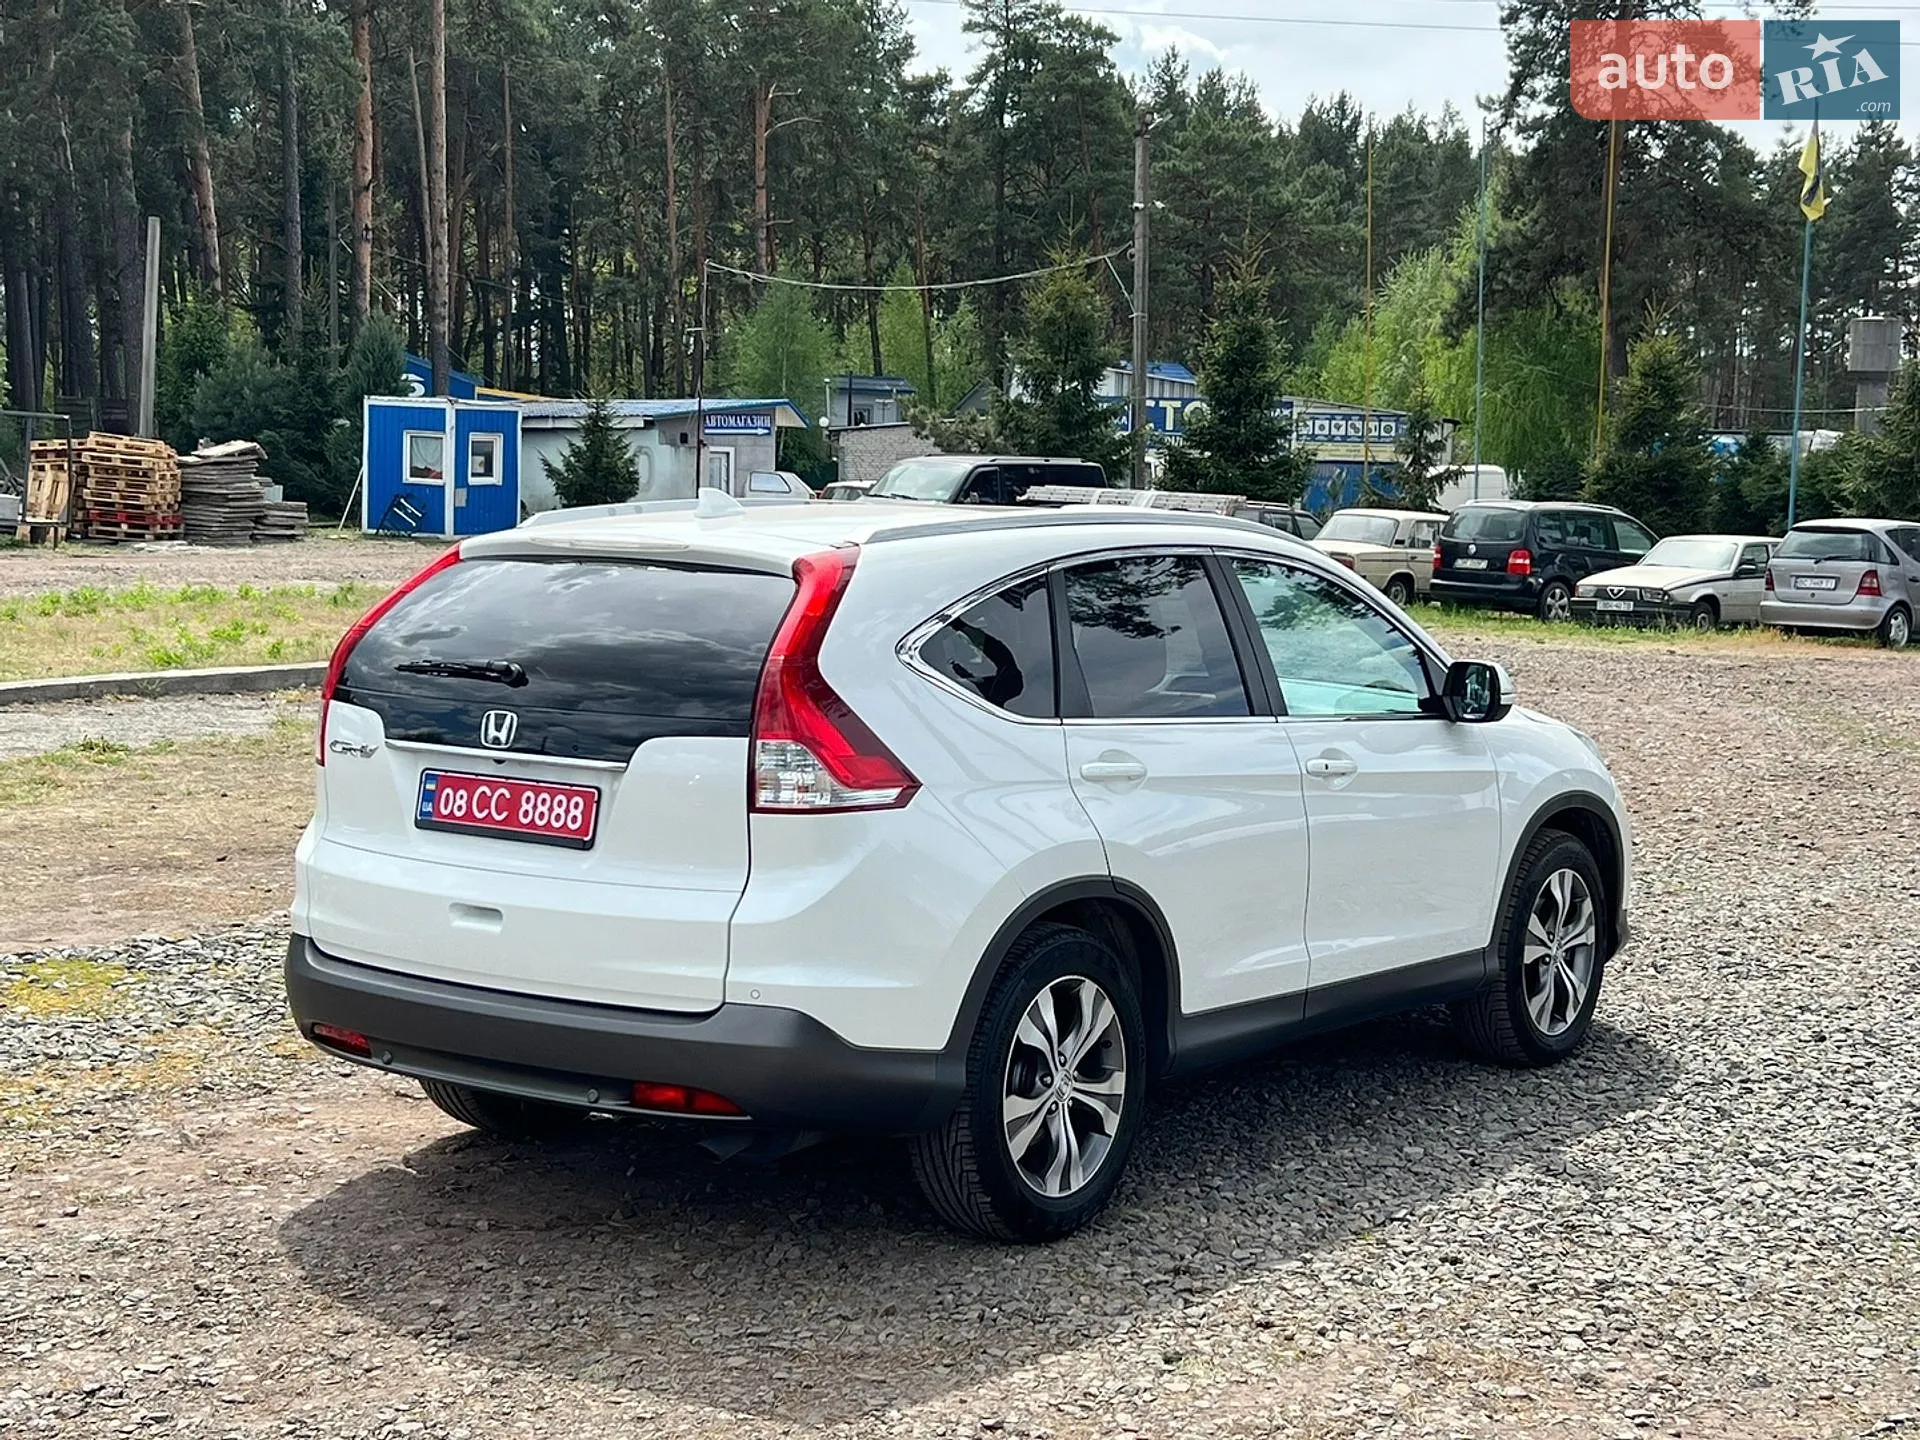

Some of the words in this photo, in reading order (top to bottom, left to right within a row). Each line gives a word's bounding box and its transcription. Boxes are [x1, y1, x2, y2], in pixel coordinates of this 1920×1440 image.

[704, 414, 771, 428] АВТОМАГАЗИН
[439, 787, 468, 818] 08
[471, 785, 512, 822] CC
[517, 790, 586, 831] 8888
